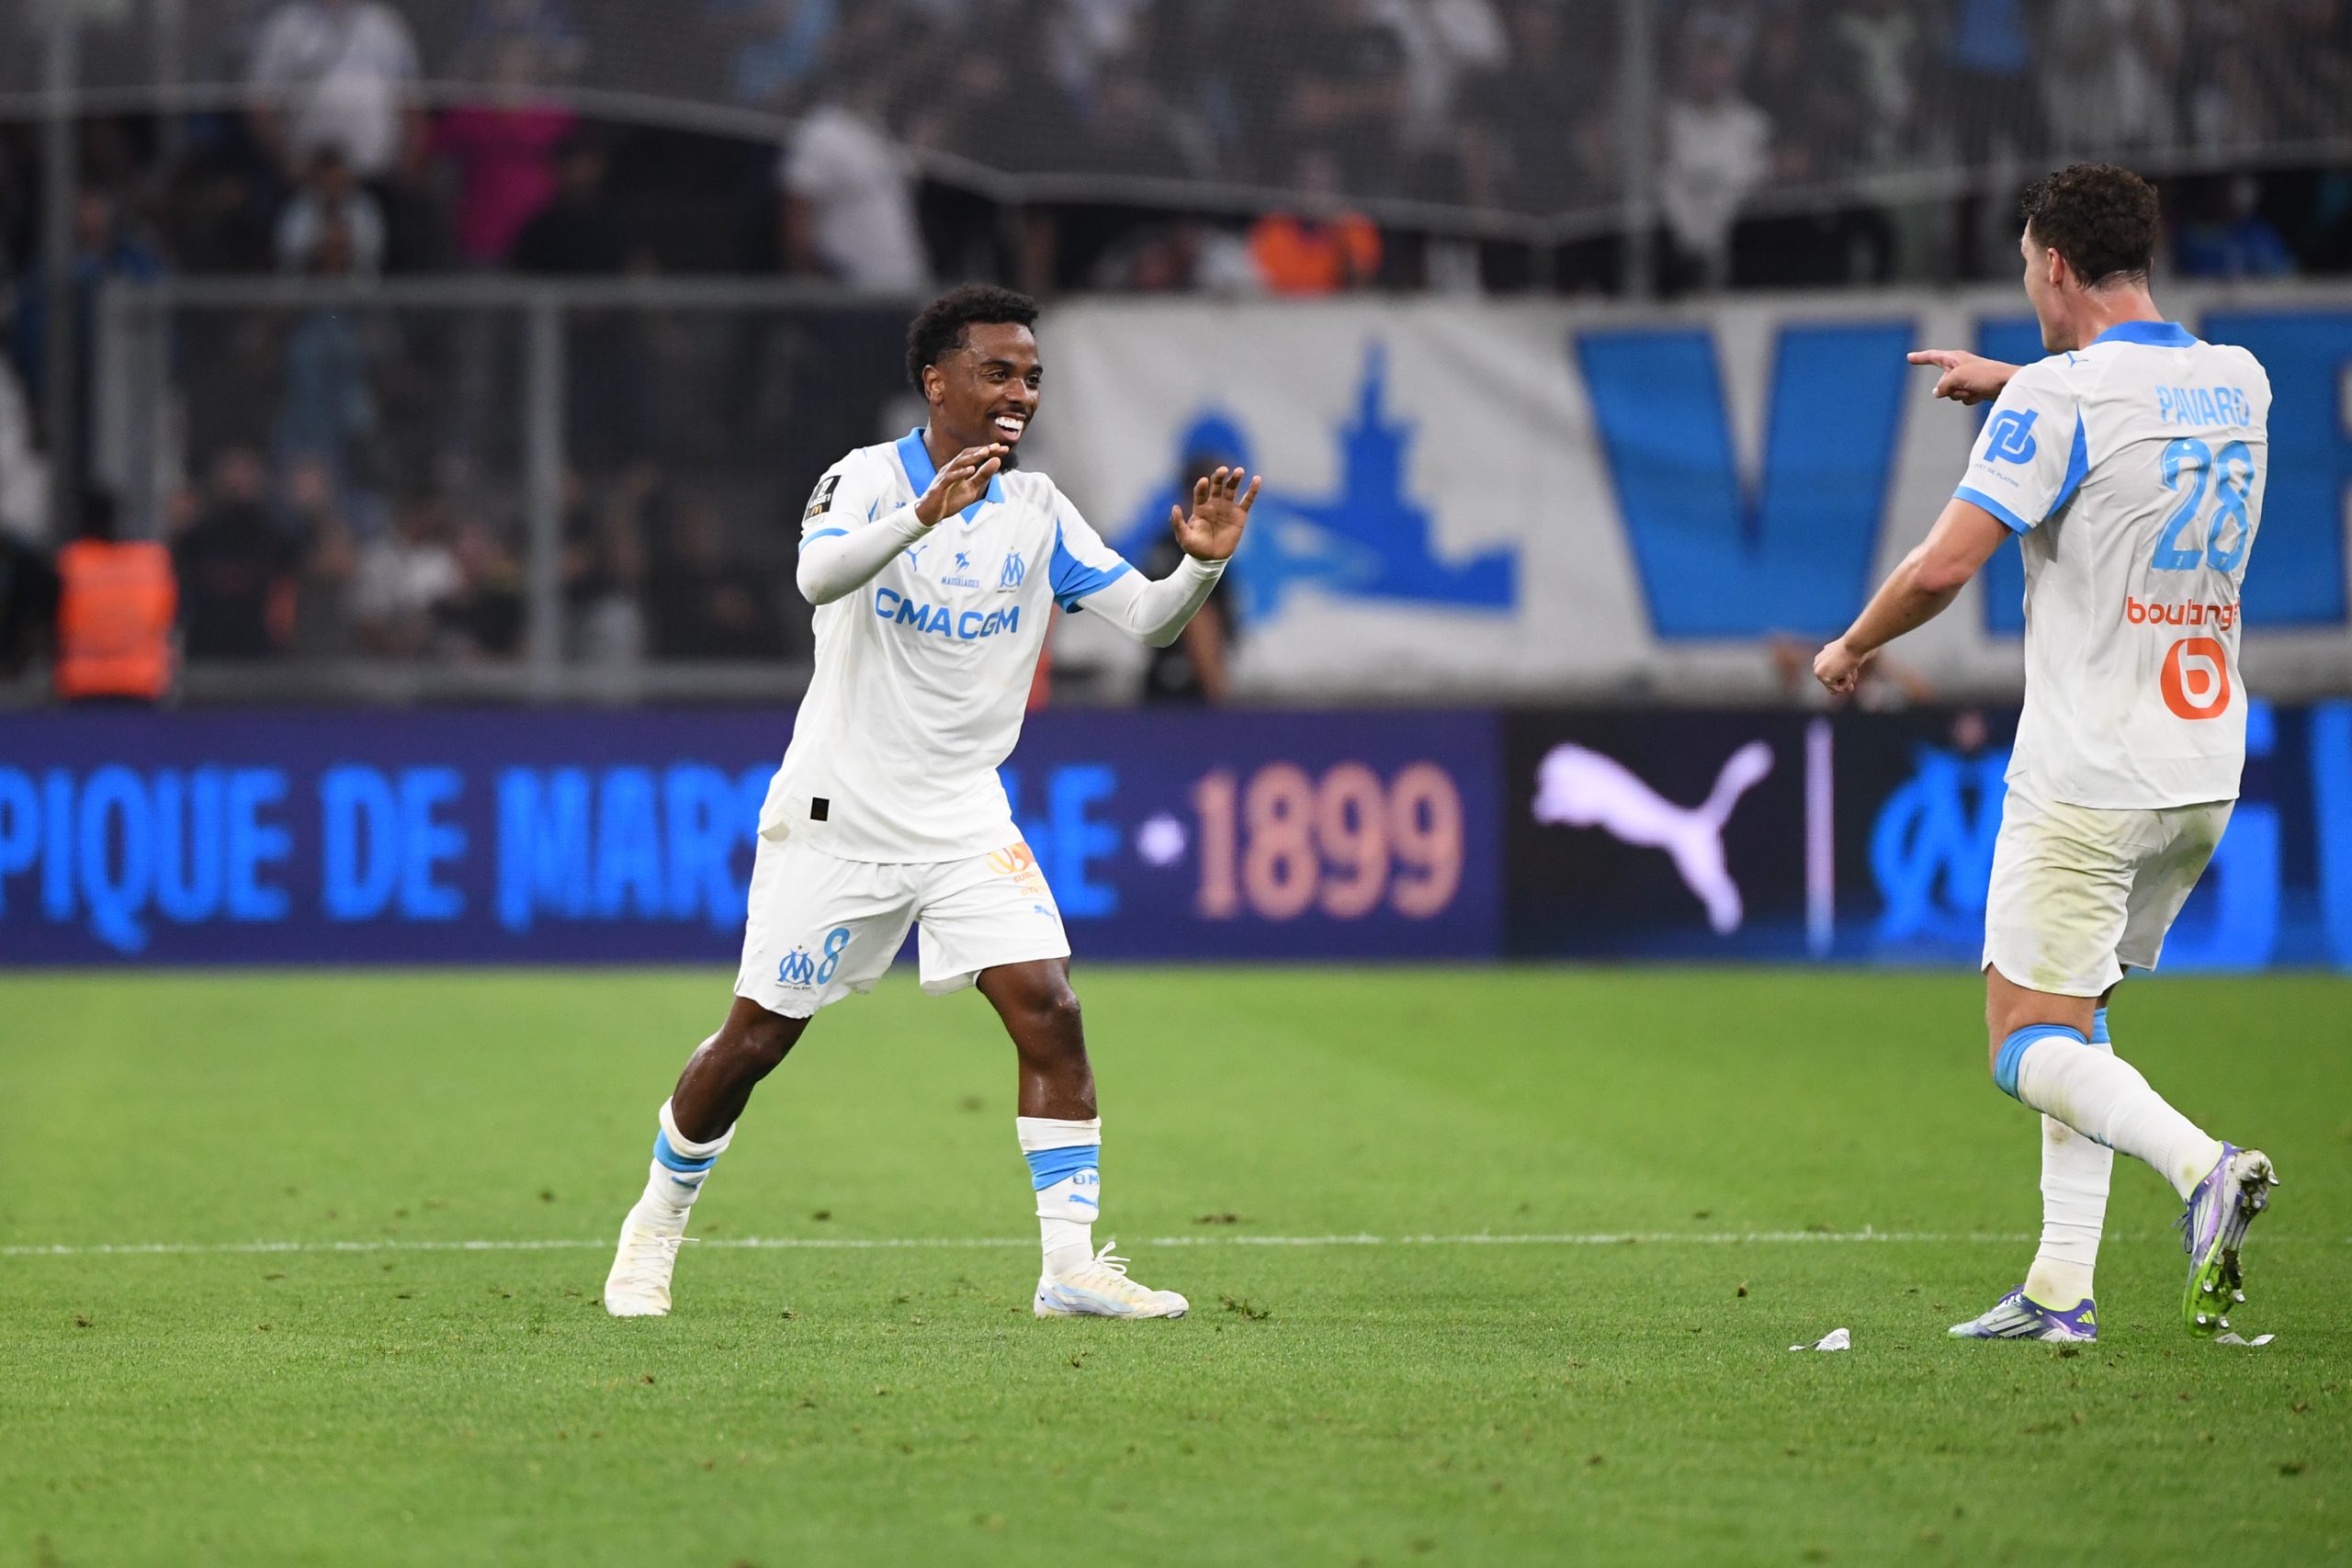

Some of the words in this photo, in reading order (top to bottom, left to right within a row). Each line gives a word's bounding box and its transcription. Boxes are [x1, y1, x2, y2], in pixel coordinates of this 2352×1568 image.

[2156, 385, 2250, 426] PAVARD
[2151, 438, 2256, 574] 28
[876, 587, 952, 637] CMA
[958, 605, 1020, 639] CGM
[322, 764, 465, 919] DE
[1193, 761, 1463, 919] 1899
[817, 927, 850, 985] 8
